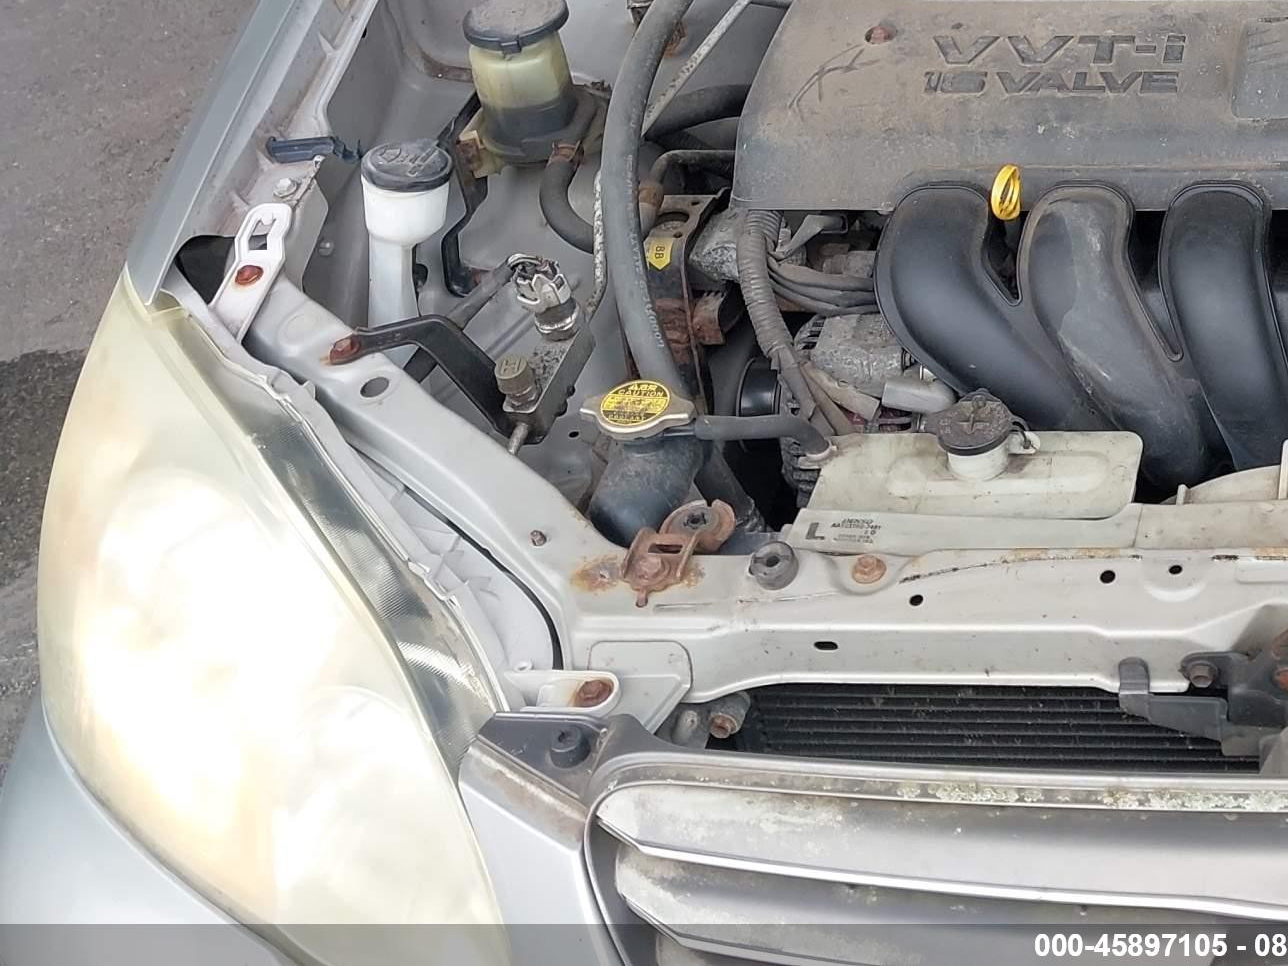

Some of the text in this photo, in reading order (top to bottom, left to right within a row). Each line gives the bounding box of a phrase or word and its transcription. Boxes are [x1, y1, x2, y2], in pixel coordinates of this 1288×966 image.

[932, 34, 1187, 65] VVT-i
[996, 71, 1180, 94] VALVE
[618, 389, 664, 397] CAUTION
[805, 521, 825, 540] L
